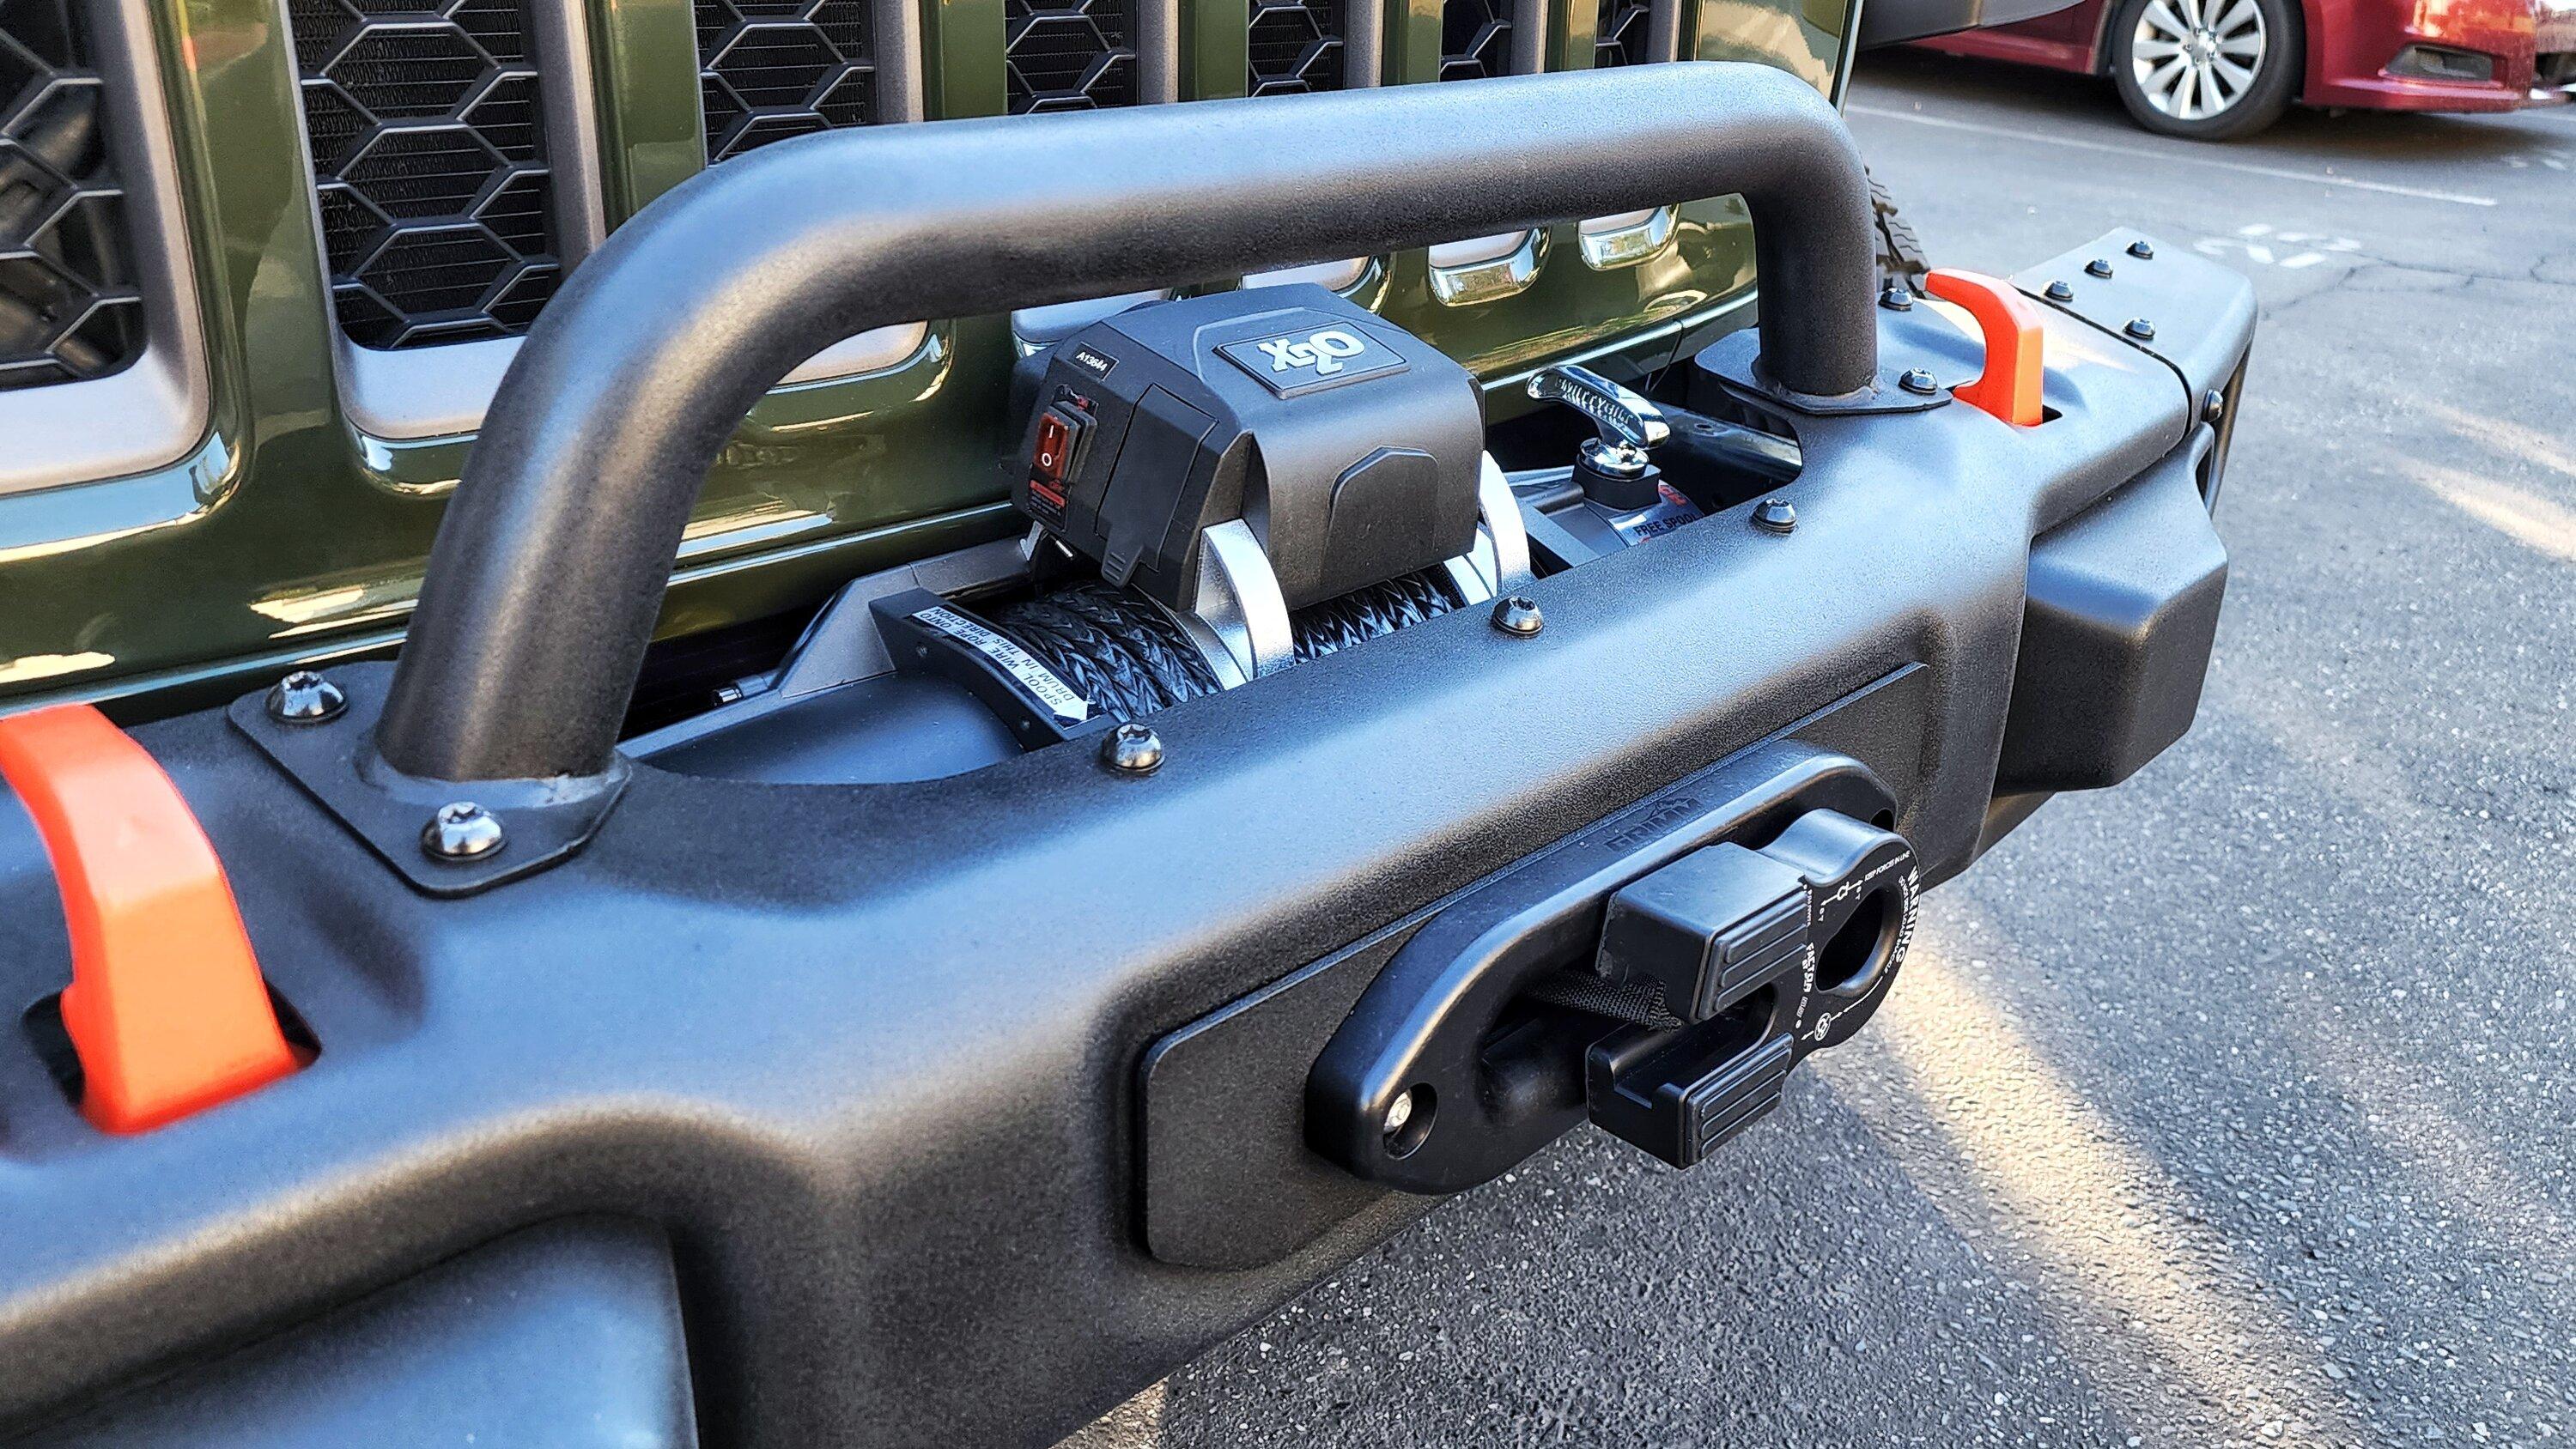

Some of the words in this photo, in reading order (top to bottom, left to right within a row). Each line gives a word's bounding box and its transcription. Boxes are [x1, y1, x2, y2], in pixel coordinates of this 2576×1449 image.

[1257, 330, 1365, 375] X2O
[1632, 520, 1664, 537] FREE
[1662, 512, 1704, 530] SPOOL
[920, 612, 951, 628] ONTO
[930, 608, 991, 637] DIRECTION
[954, 629, 987, 646] ROPE
[992, 639, 1019, 655] THIS
[989, 647, 1020, 670] WIRE
[1021, 658, 1039, 669] IN
[1024, 672, 1062, 706] SPOOL
[1038, 673, 1075, 700] DRUM
[1895, 865, 1920, 963] WARNING
[1899, 913, 1907, 937] LOAD
[1802, 942, 1815, 993] FACTOR
[1884, 938, 1901, 973] SHACKLE
